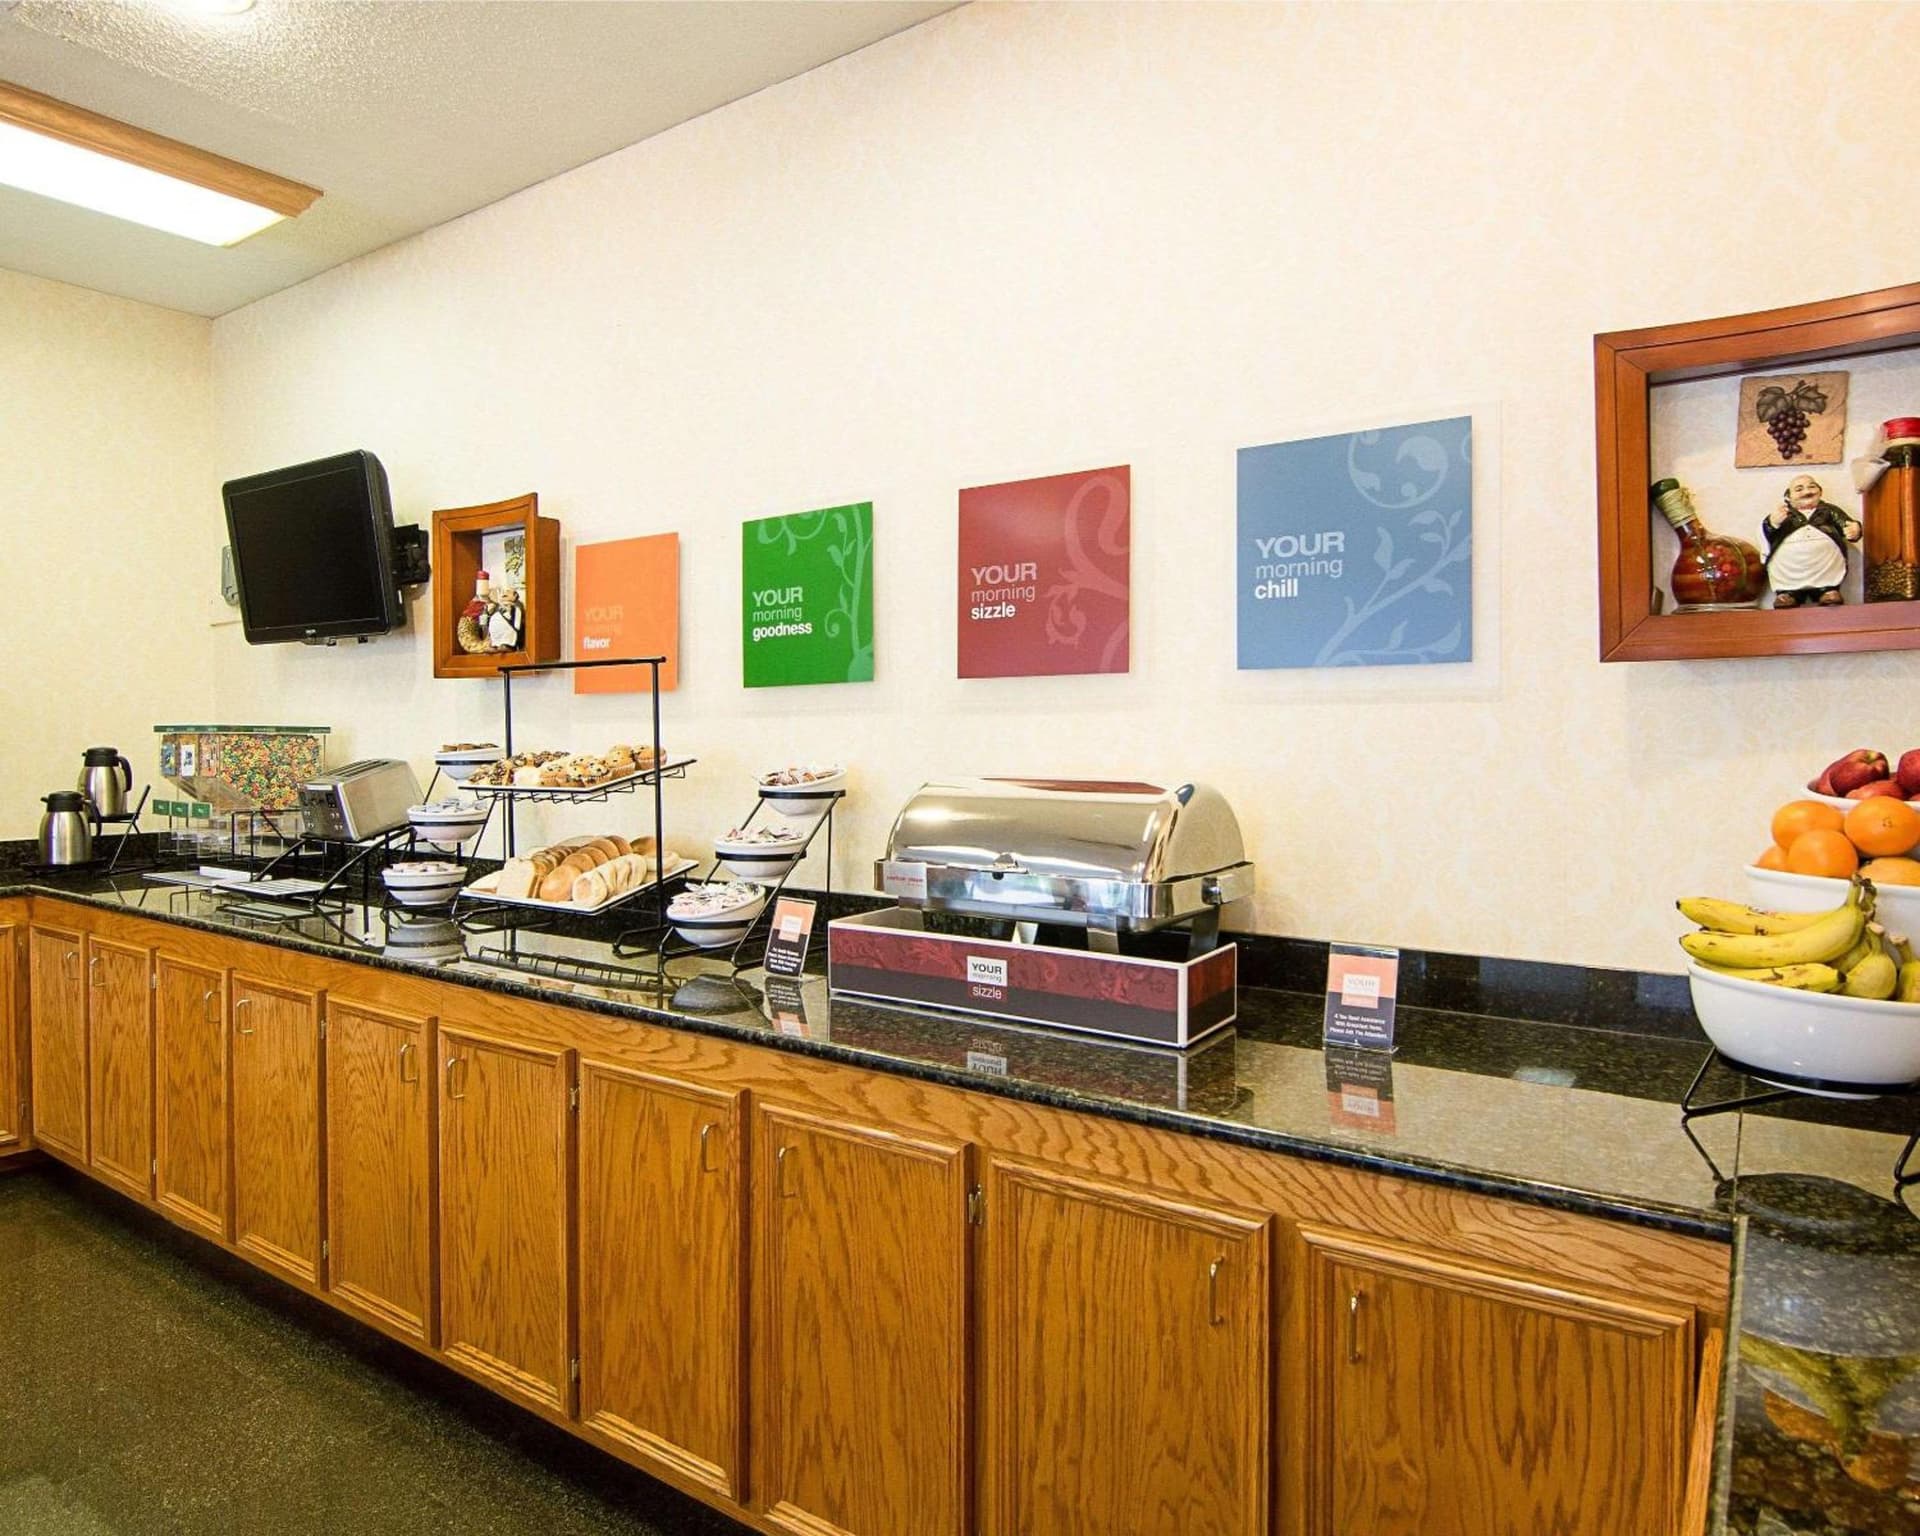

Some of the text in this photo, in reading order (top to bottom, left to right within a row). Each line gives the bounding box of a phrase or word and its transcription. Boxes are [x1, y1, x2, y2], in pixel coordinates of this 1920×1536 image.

[1255, 531, 1345, 559] YOUR
[971, 562, 1037, 586] YOUR
[1256, 557, 1342, 579] morning
[752, 587, 803, 607] YOUR
[971, 584, 1036, 602] morning
[1255, 578, 1298, 600] chill
[584, 605, 623, 622] YOUR
[753, 605, 802, 622] morning
[971, 601, 1016, 620] sizzle
[753, 621, 813, 642] goodness
[583, 636, 611, 650] flavor
[972, 962, 1002, 974] YOUR
[972, 984, 1002, 1000] sizzle
